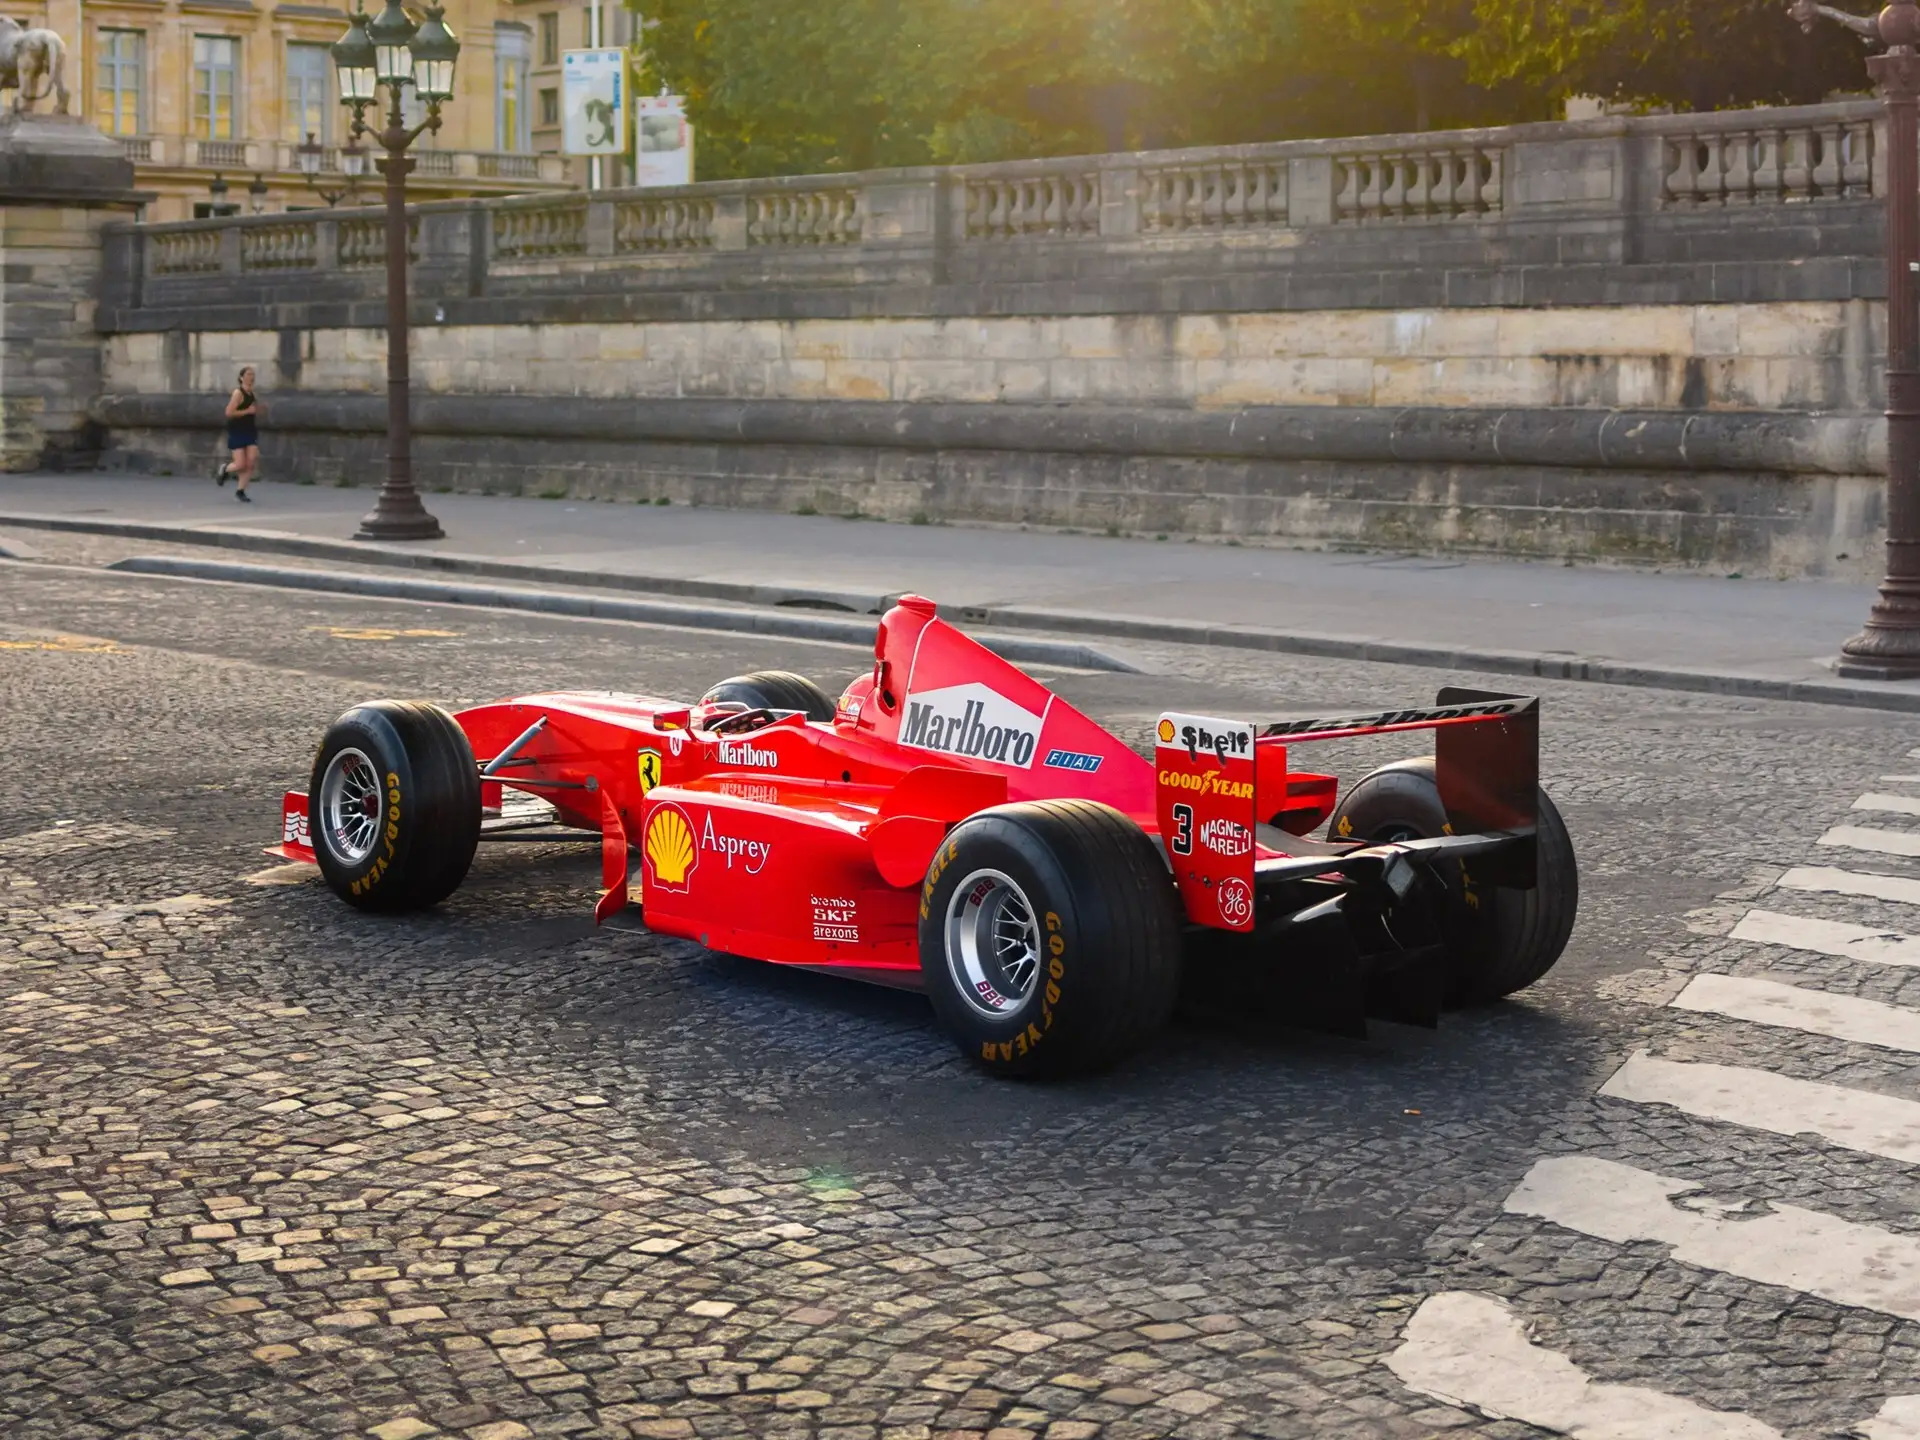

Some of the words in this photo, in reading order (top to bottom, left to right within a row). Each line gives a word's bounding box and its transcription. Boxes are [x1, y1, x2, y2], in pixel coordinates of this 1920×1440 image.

[902, 699, 1035, 766] Marlboro
[718, 741, 778, 768] Marlboro
[1049, 752, 1098, 770] FIAT
[701, 809, 771, 874] Asprey
[1171, 802, 1194, 856] 3
[919, 839, 959, 920] EAGLE
[810, 893, 856, 908] brembo
[813, 908, 857, 922] SKF
[813, 926, 859, 940] arexons
